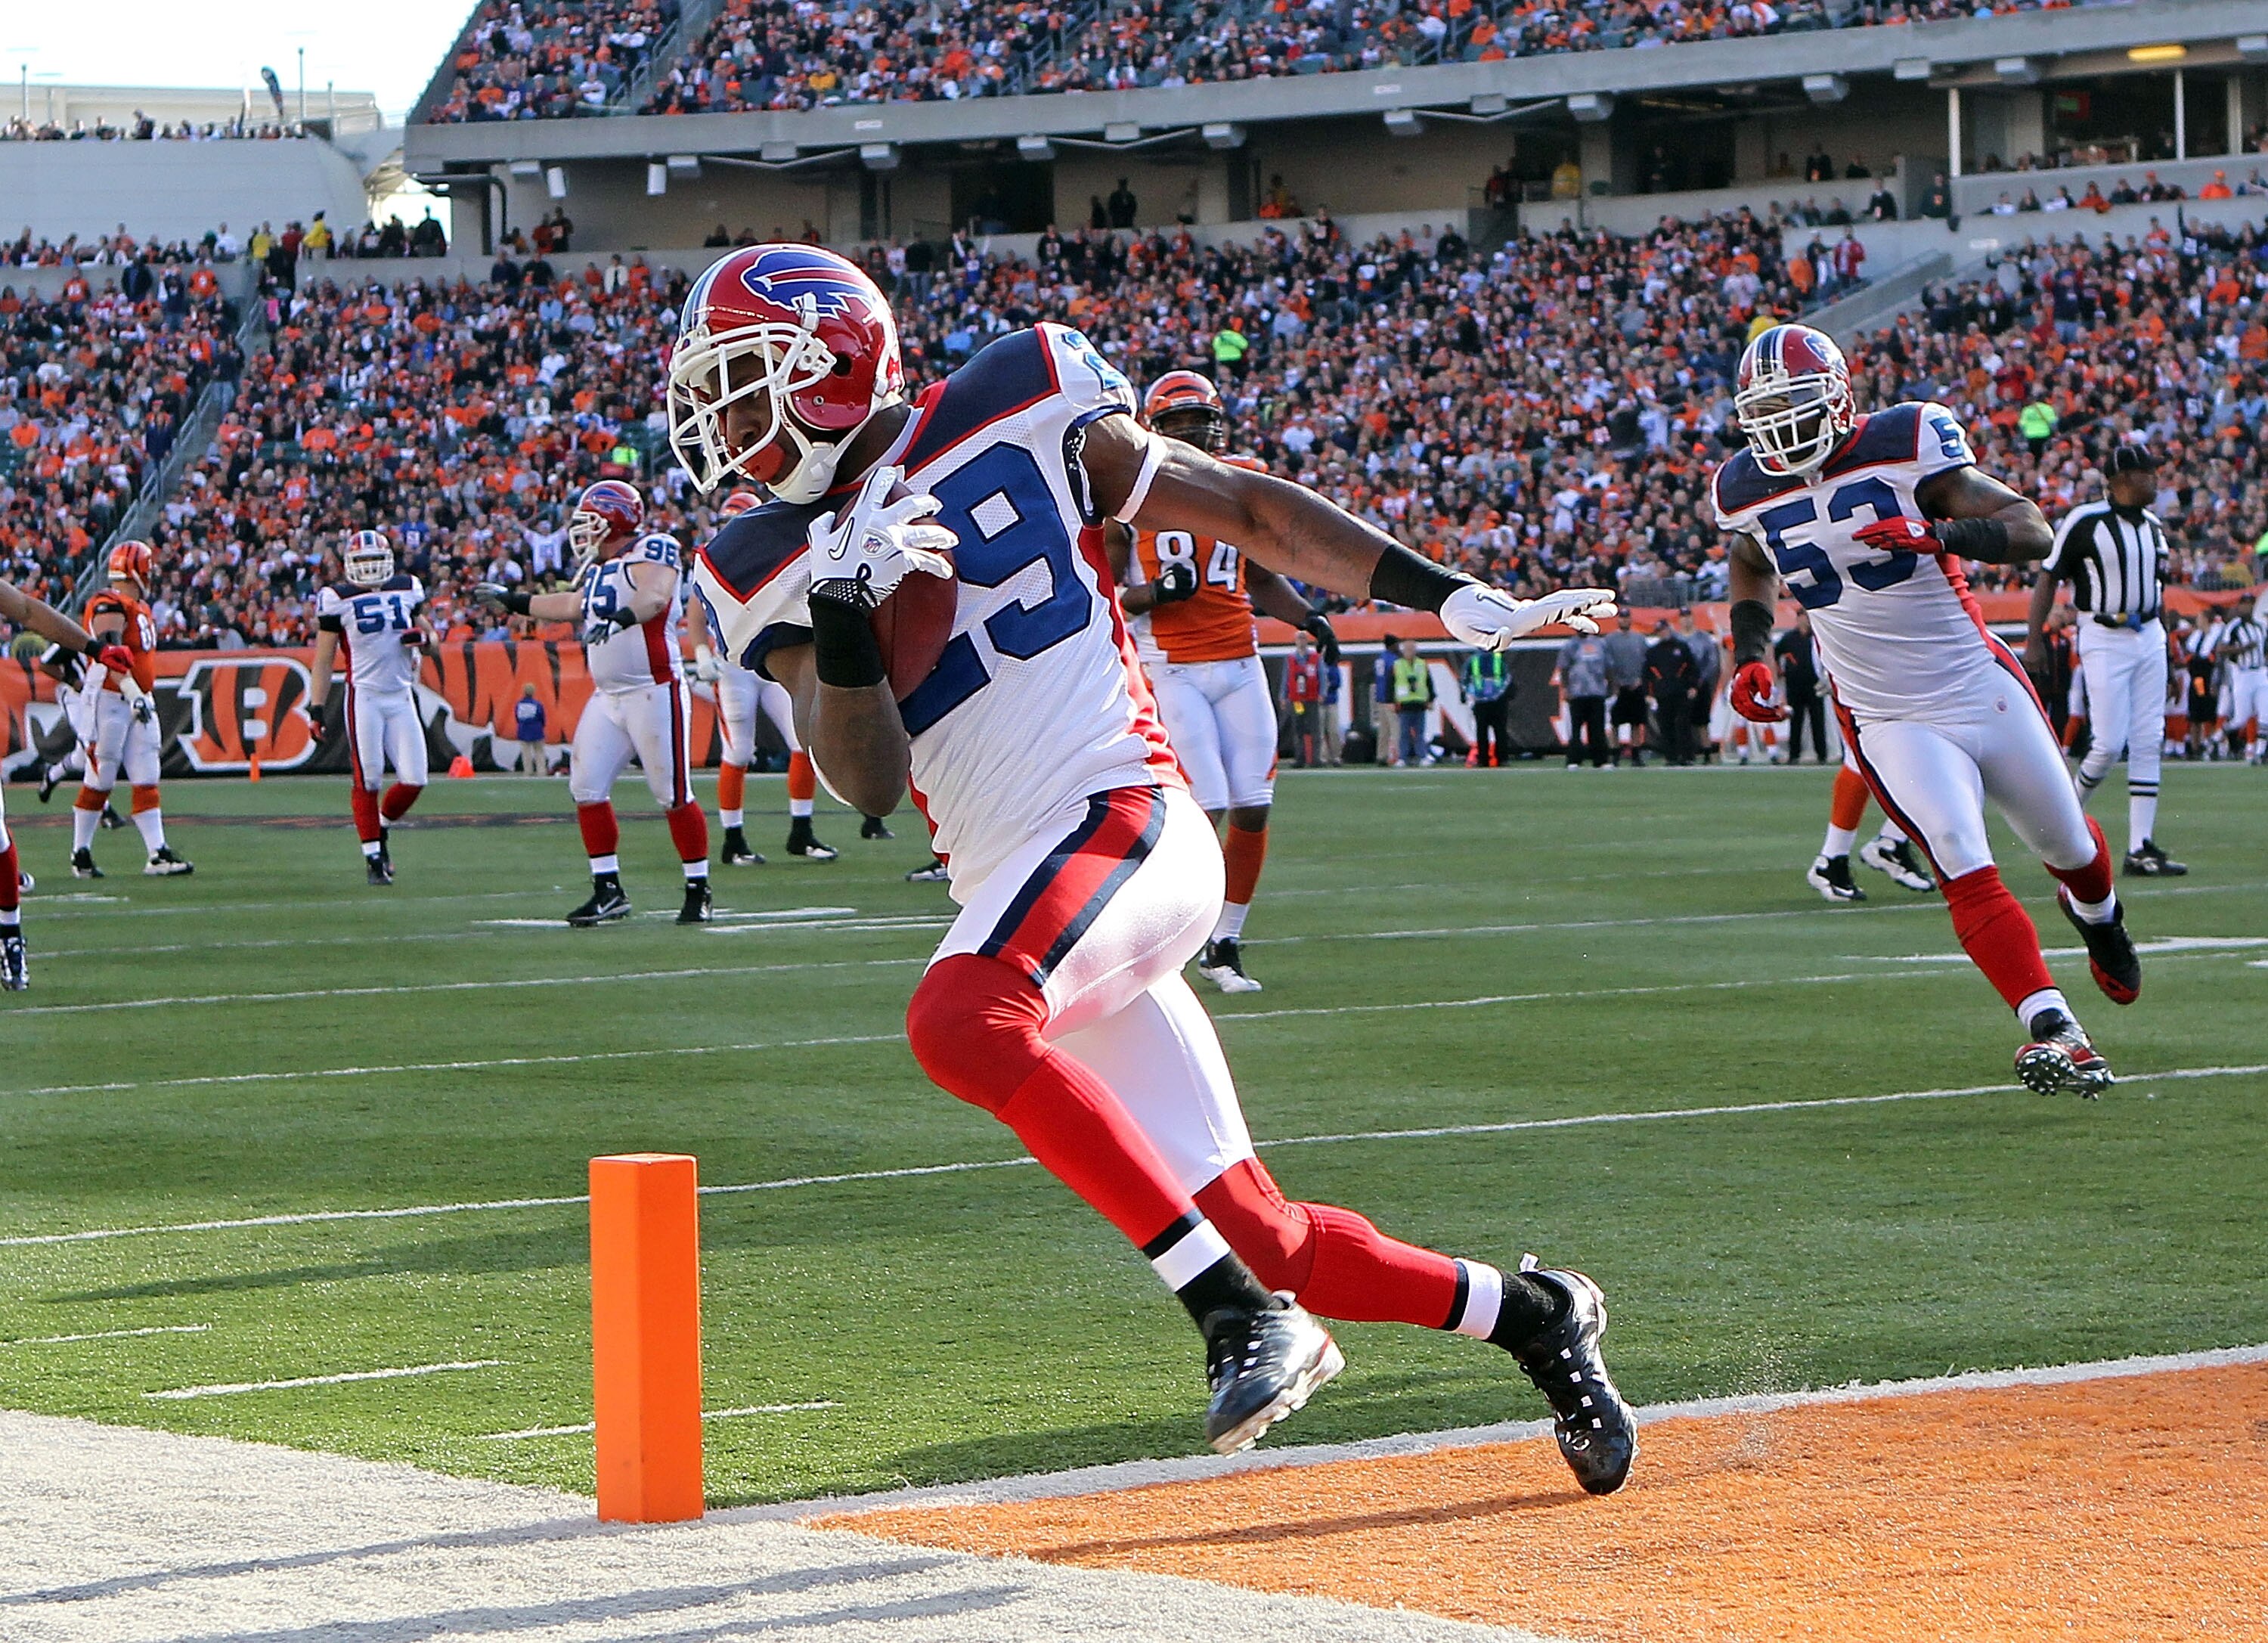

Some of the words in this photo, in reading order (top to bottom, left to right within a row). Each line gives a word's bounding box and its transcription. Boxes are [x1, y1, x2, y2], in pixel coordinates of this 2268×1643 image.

[1155, 529, 1240, 593] 84
[1757, 476, 1919, 610] 53
[136, 612, 157, 652] 8
[352, 594, 408, 634] 51
[177, 656, 313, 772] B
